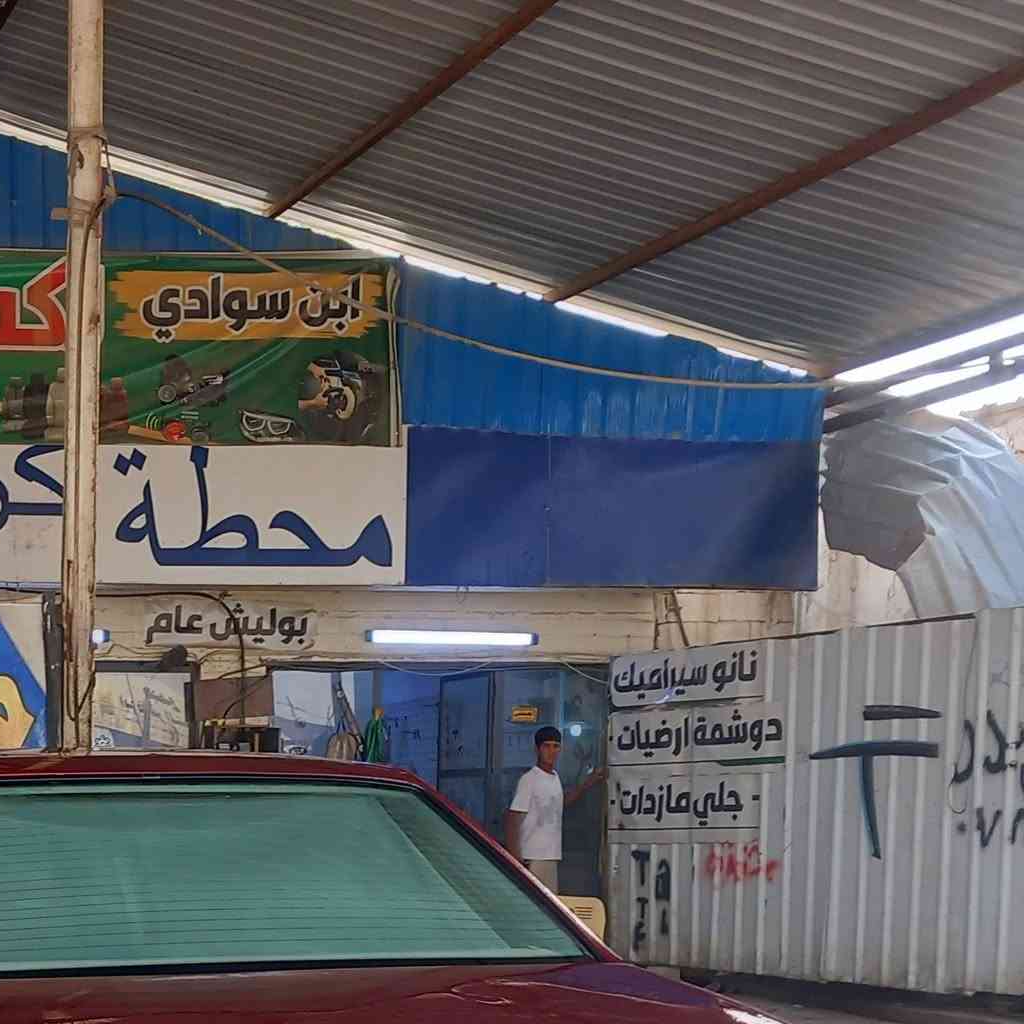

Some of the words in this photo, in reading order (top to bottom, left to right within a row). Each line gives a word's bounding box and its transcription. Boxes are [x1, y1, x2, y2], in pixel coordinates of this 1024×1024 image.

[141, 272, 292, 343] سوادي
[298, 273, 364, 335] ابن
[113, 446, 392, 567] محطة
[144, 604, 203, 645] عام
[209, 603, 308, 644] بوليش
[712, 650, 758, 692] نانو
[617, 715, 690, 757] ارضيات
[693, 709, 783, 751] دوشمة
[619, 784, 691, 823] مازدات
[692, 781, 744, 826] جلي
